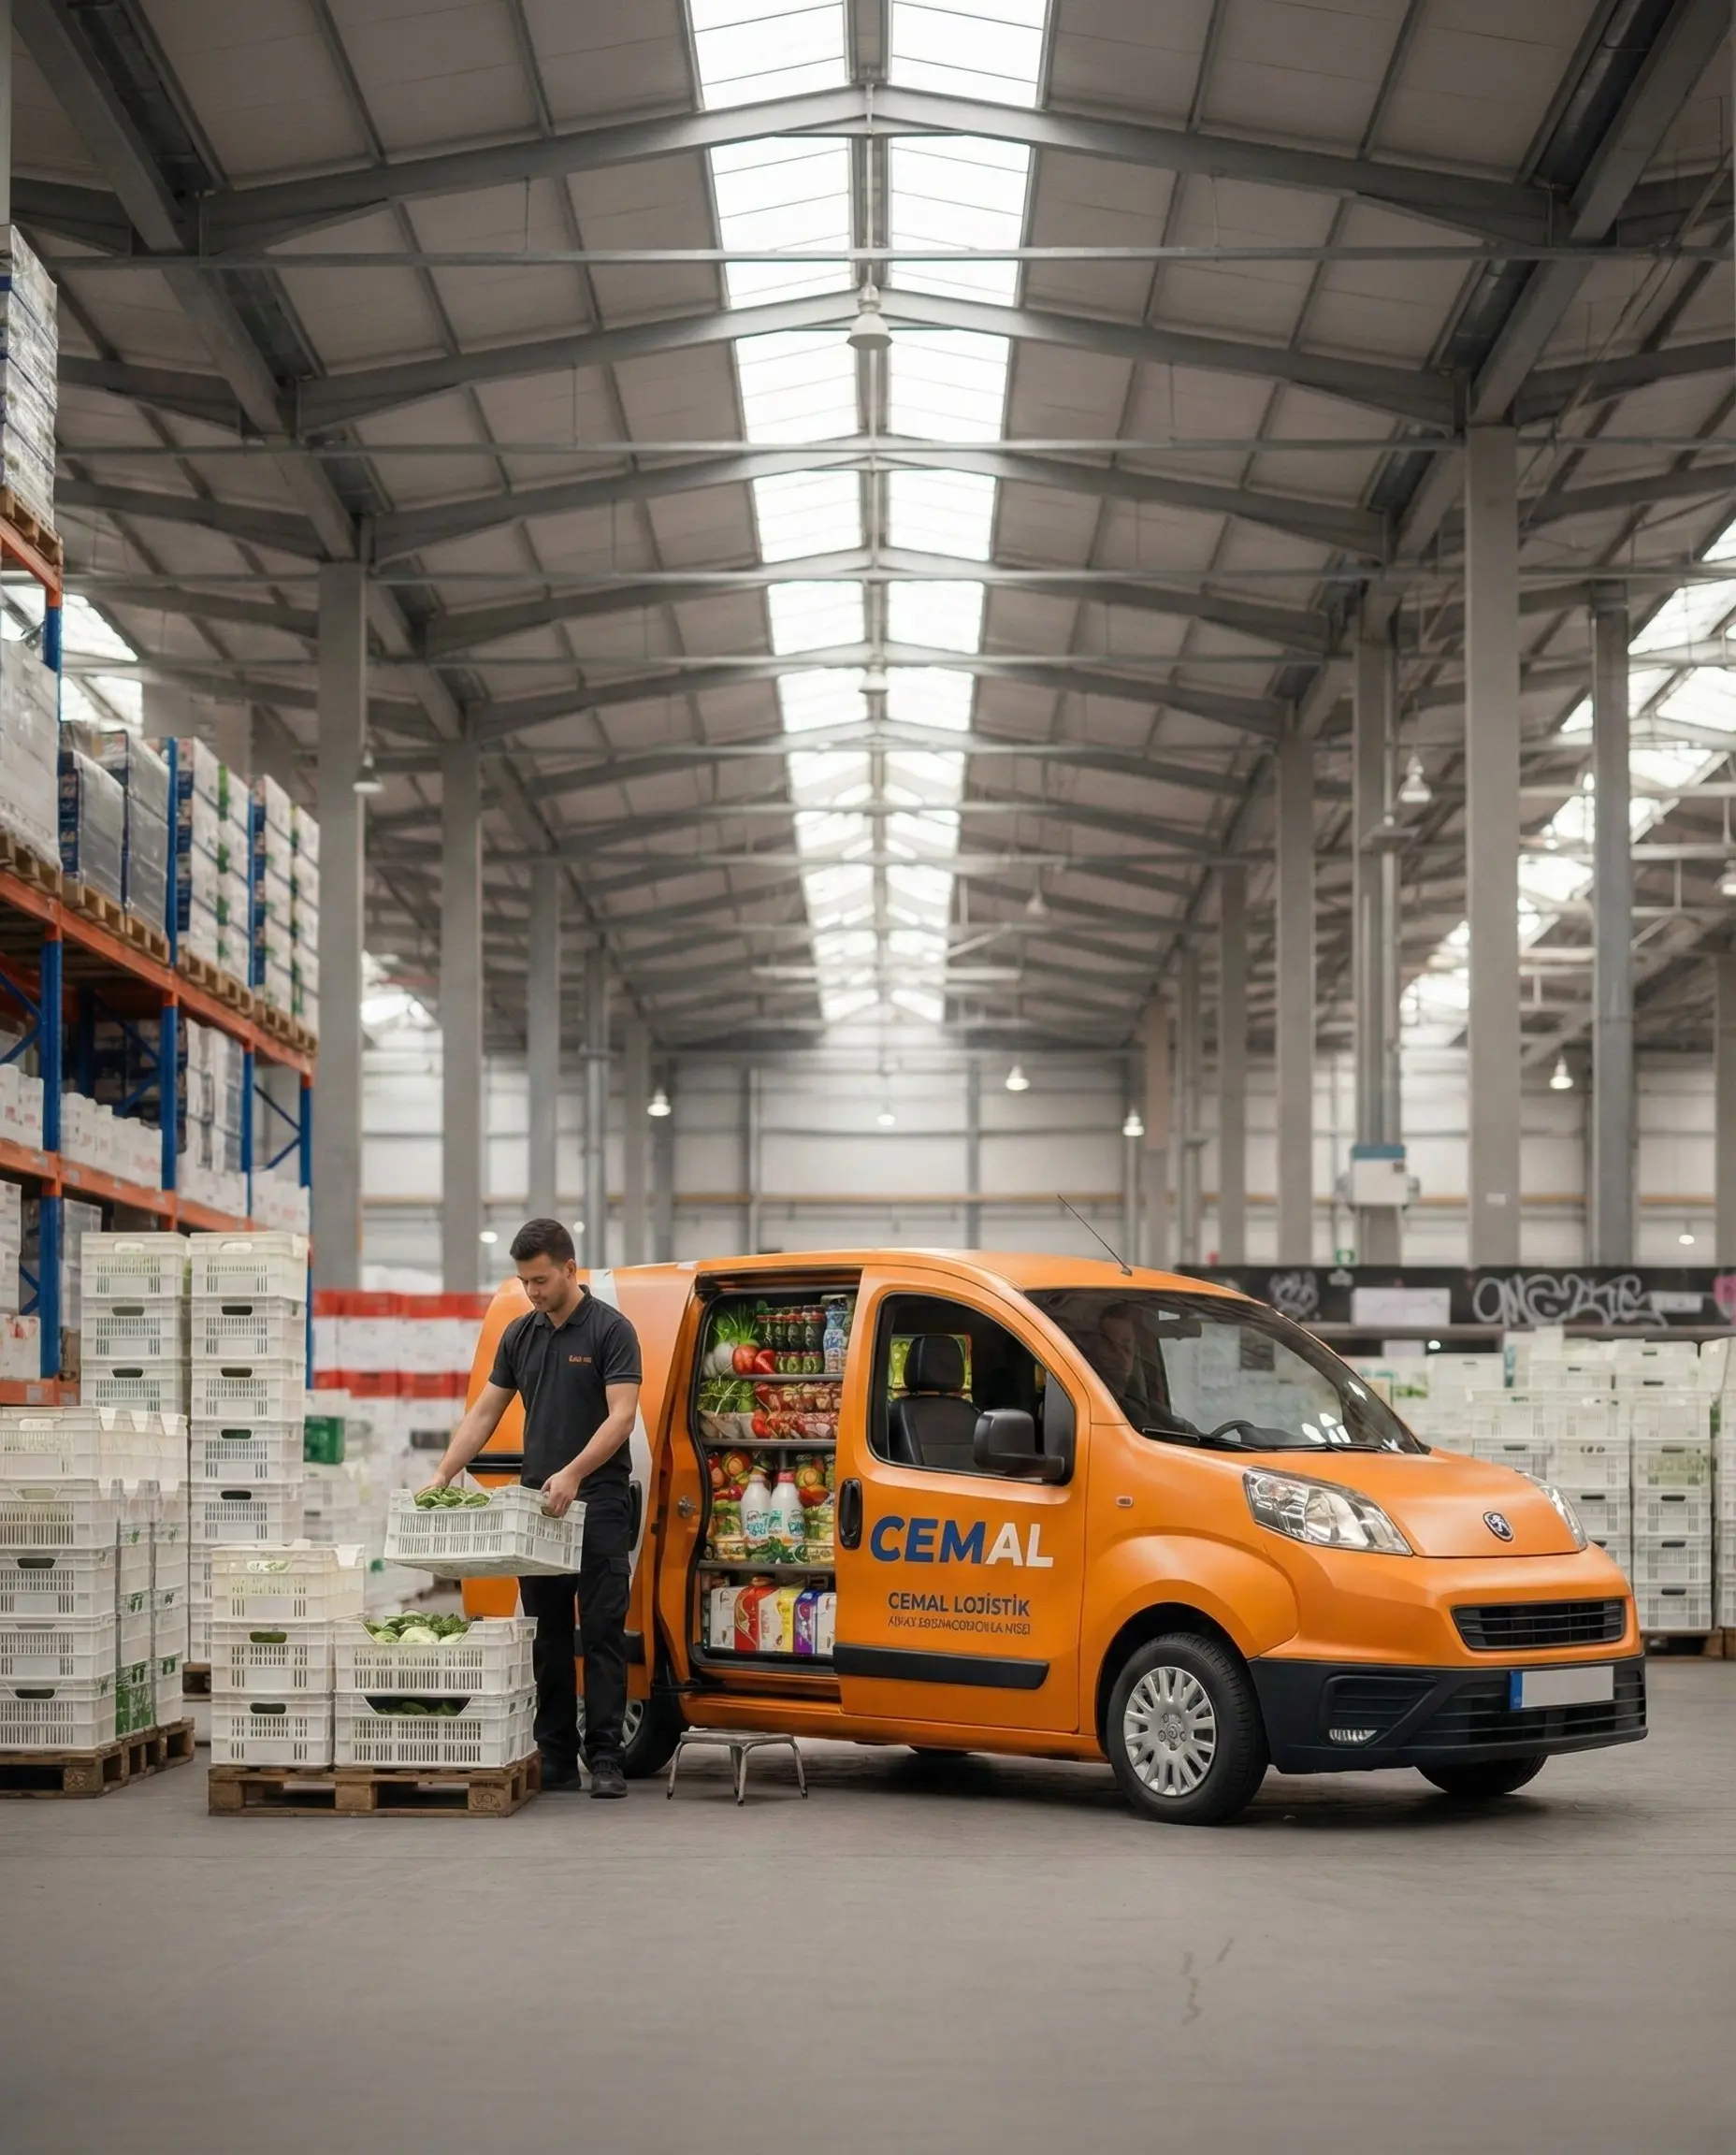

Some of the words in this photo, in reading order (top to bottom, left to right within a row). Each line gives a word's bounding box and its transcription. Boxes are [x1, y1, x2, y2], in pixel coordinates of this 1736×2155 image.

[870, 1515, 1054, 1568] CEMAL
[888, 1592, 949, 1612] CEMAL
[954, 1592, 1031, 1617] LOJİSTİK
